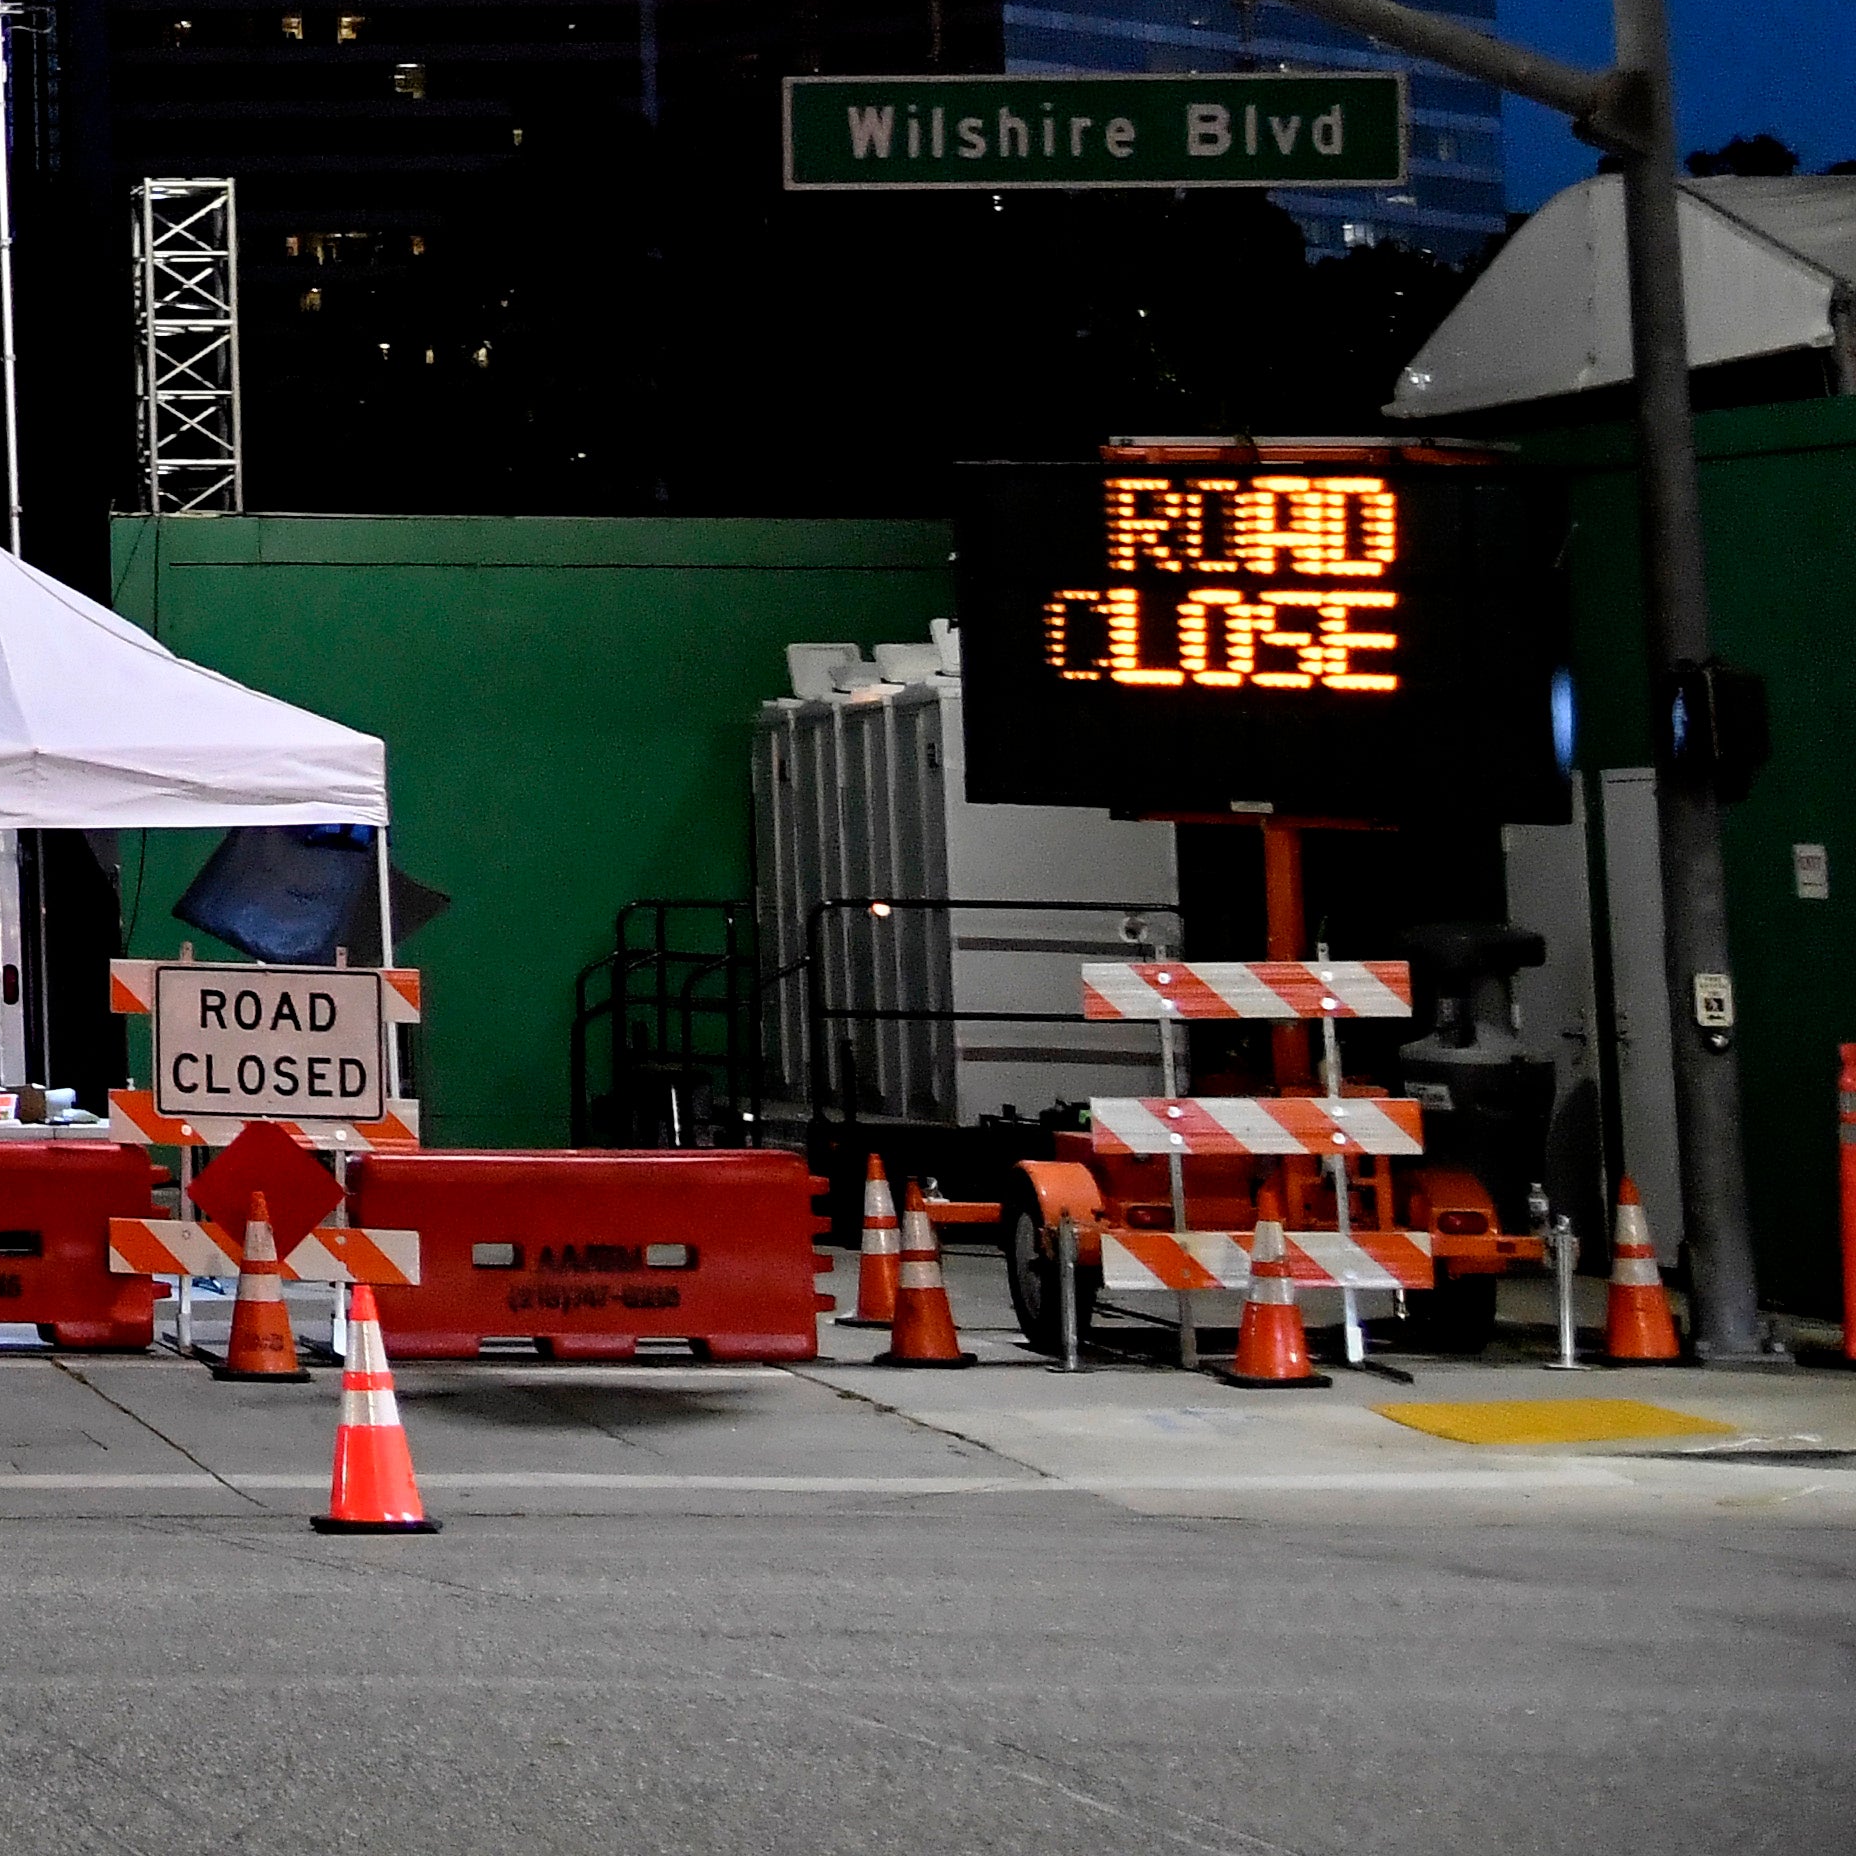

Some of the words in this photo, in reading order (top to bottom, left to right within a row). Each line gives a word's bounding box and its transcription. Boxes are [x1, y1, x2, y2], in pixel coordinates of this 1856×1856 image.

[847, 104, 1137, 160] Wilshire
[1186, 103, 1344, 156] Blvd
[1103, 475, 1399, 578] ROAD
[1043, 586, 1399, 692] CLOSE
[199, 989, 338, 1033] ROAD
[171, 1052, 368, 1098] CLOSED
